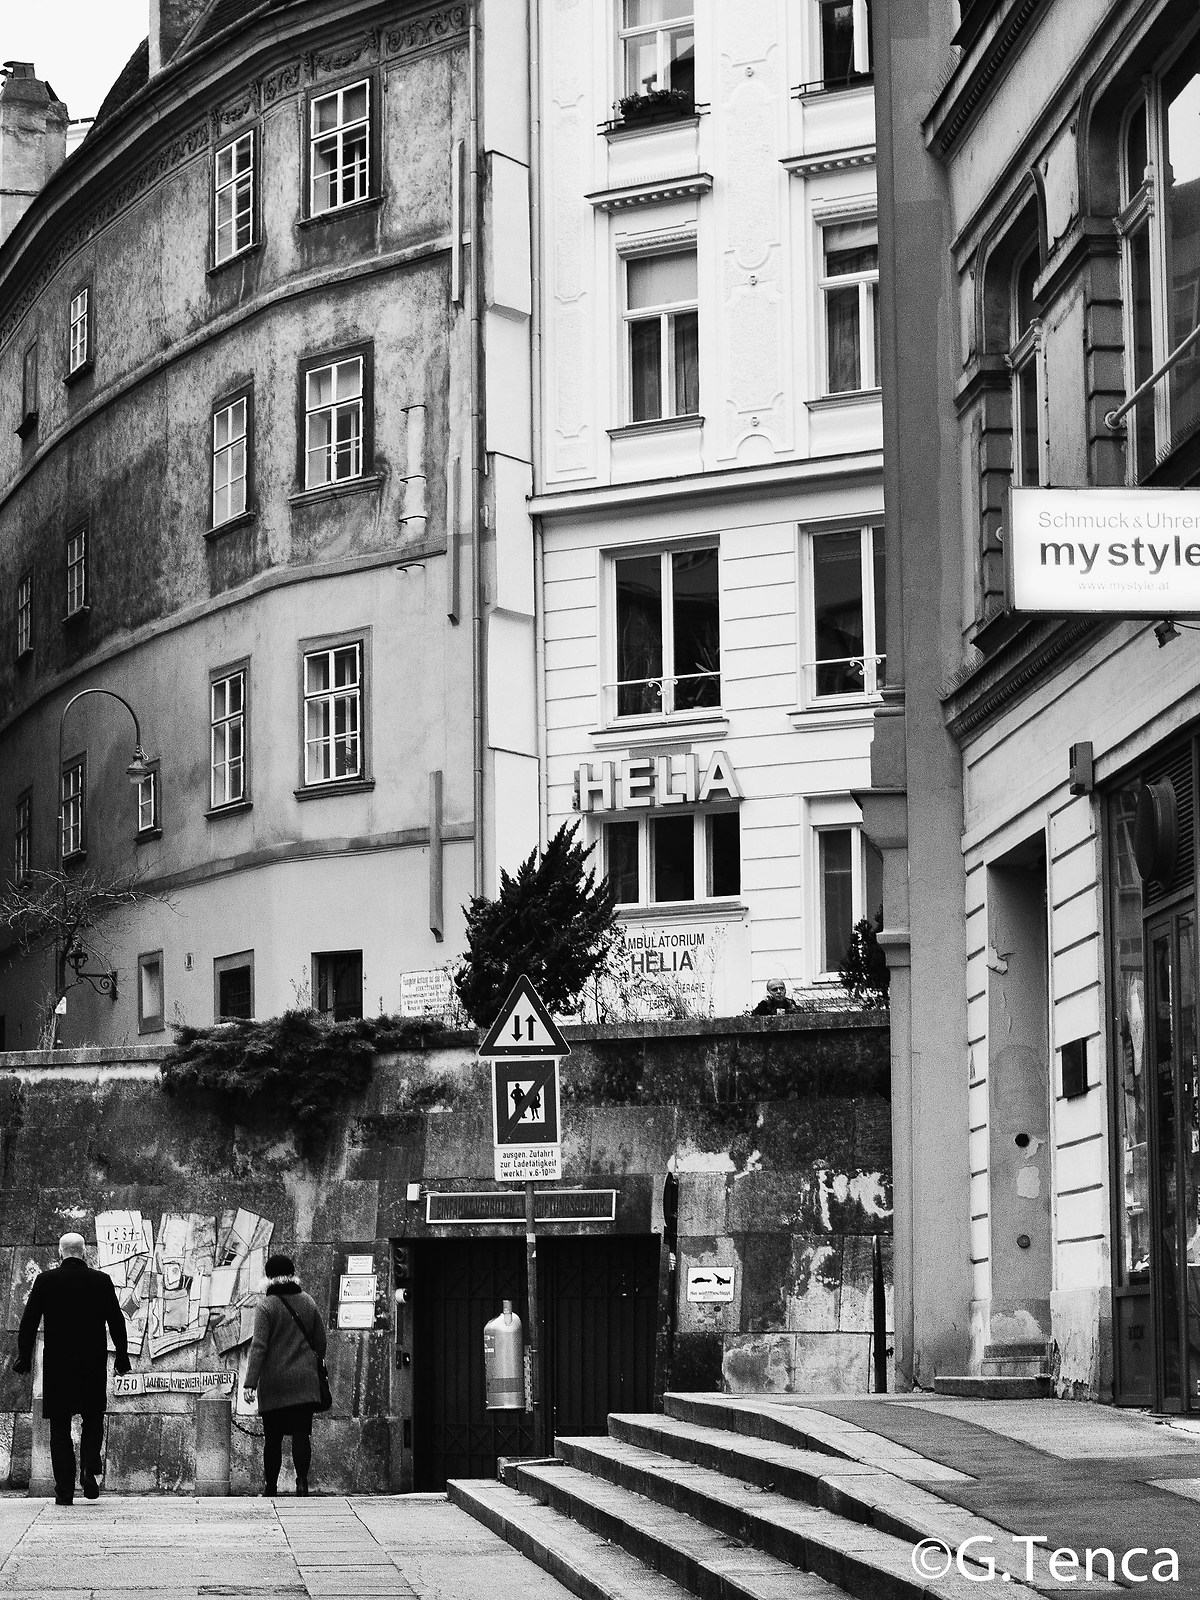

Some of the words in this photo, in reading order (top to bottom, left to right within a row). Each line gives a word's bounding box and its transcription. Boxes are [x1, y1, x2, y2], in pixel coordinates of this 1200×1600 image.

[1038, 511, 1130, 529] Schmuck
[1132, 514, 1143, 529] &
[1078, 580, 1170, 592] www.mystyle.at
[578, 750, 745, 812] HELIA
[621, 933, 705, 949] AMBULATORIUM
[630, 950, 694, 974] HELIA
[116, 1379, 138, 1391] 750
